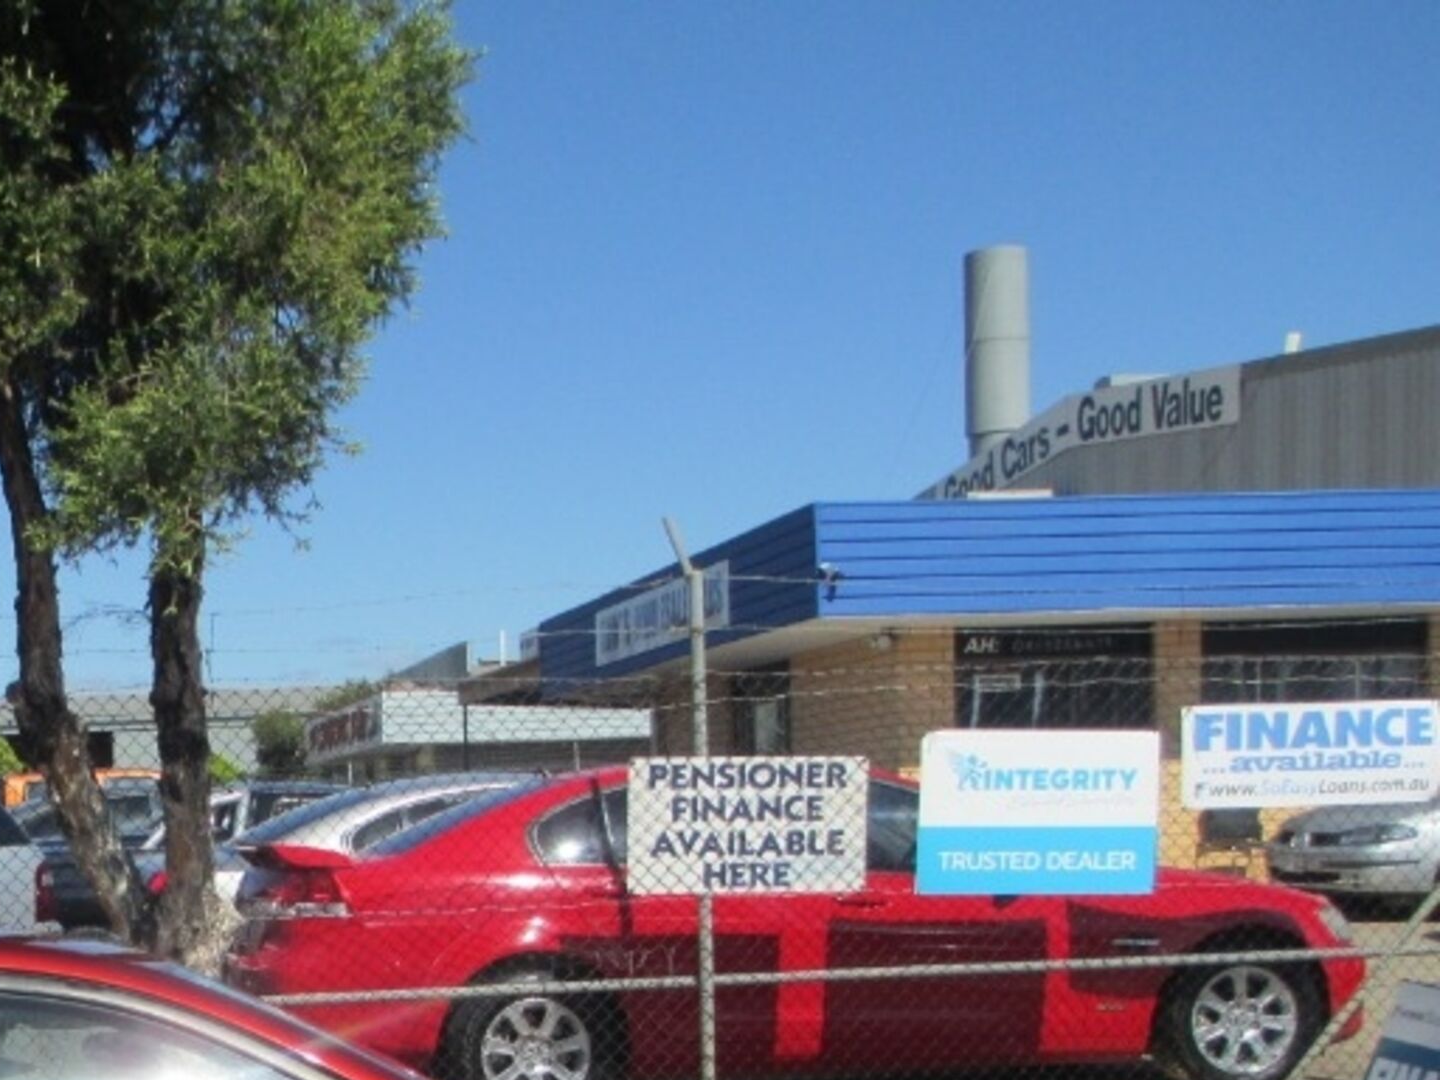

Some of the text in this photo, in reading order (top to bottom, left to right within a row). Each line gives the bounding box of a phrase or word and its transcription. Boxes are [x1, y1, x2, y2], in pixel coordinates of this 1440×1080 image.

[1001, 426, 1049, 480] Cars
[1077, 386, 1143, 441] Good
[1152, 377, 1224, 428] Value
[1194, 708, 1433, 751] FINANCE
[648, 762, 848, 789] PENSIONER
[984, 767, 1138, 791] INTEGRITY
[671, 796, 824, 822] FINANCE
[651, 830, 845, 856] AVAILABLE
[938, 850, 1136, 871] TRUSTED DEALER
[703, 863, 791, 888] HERE
